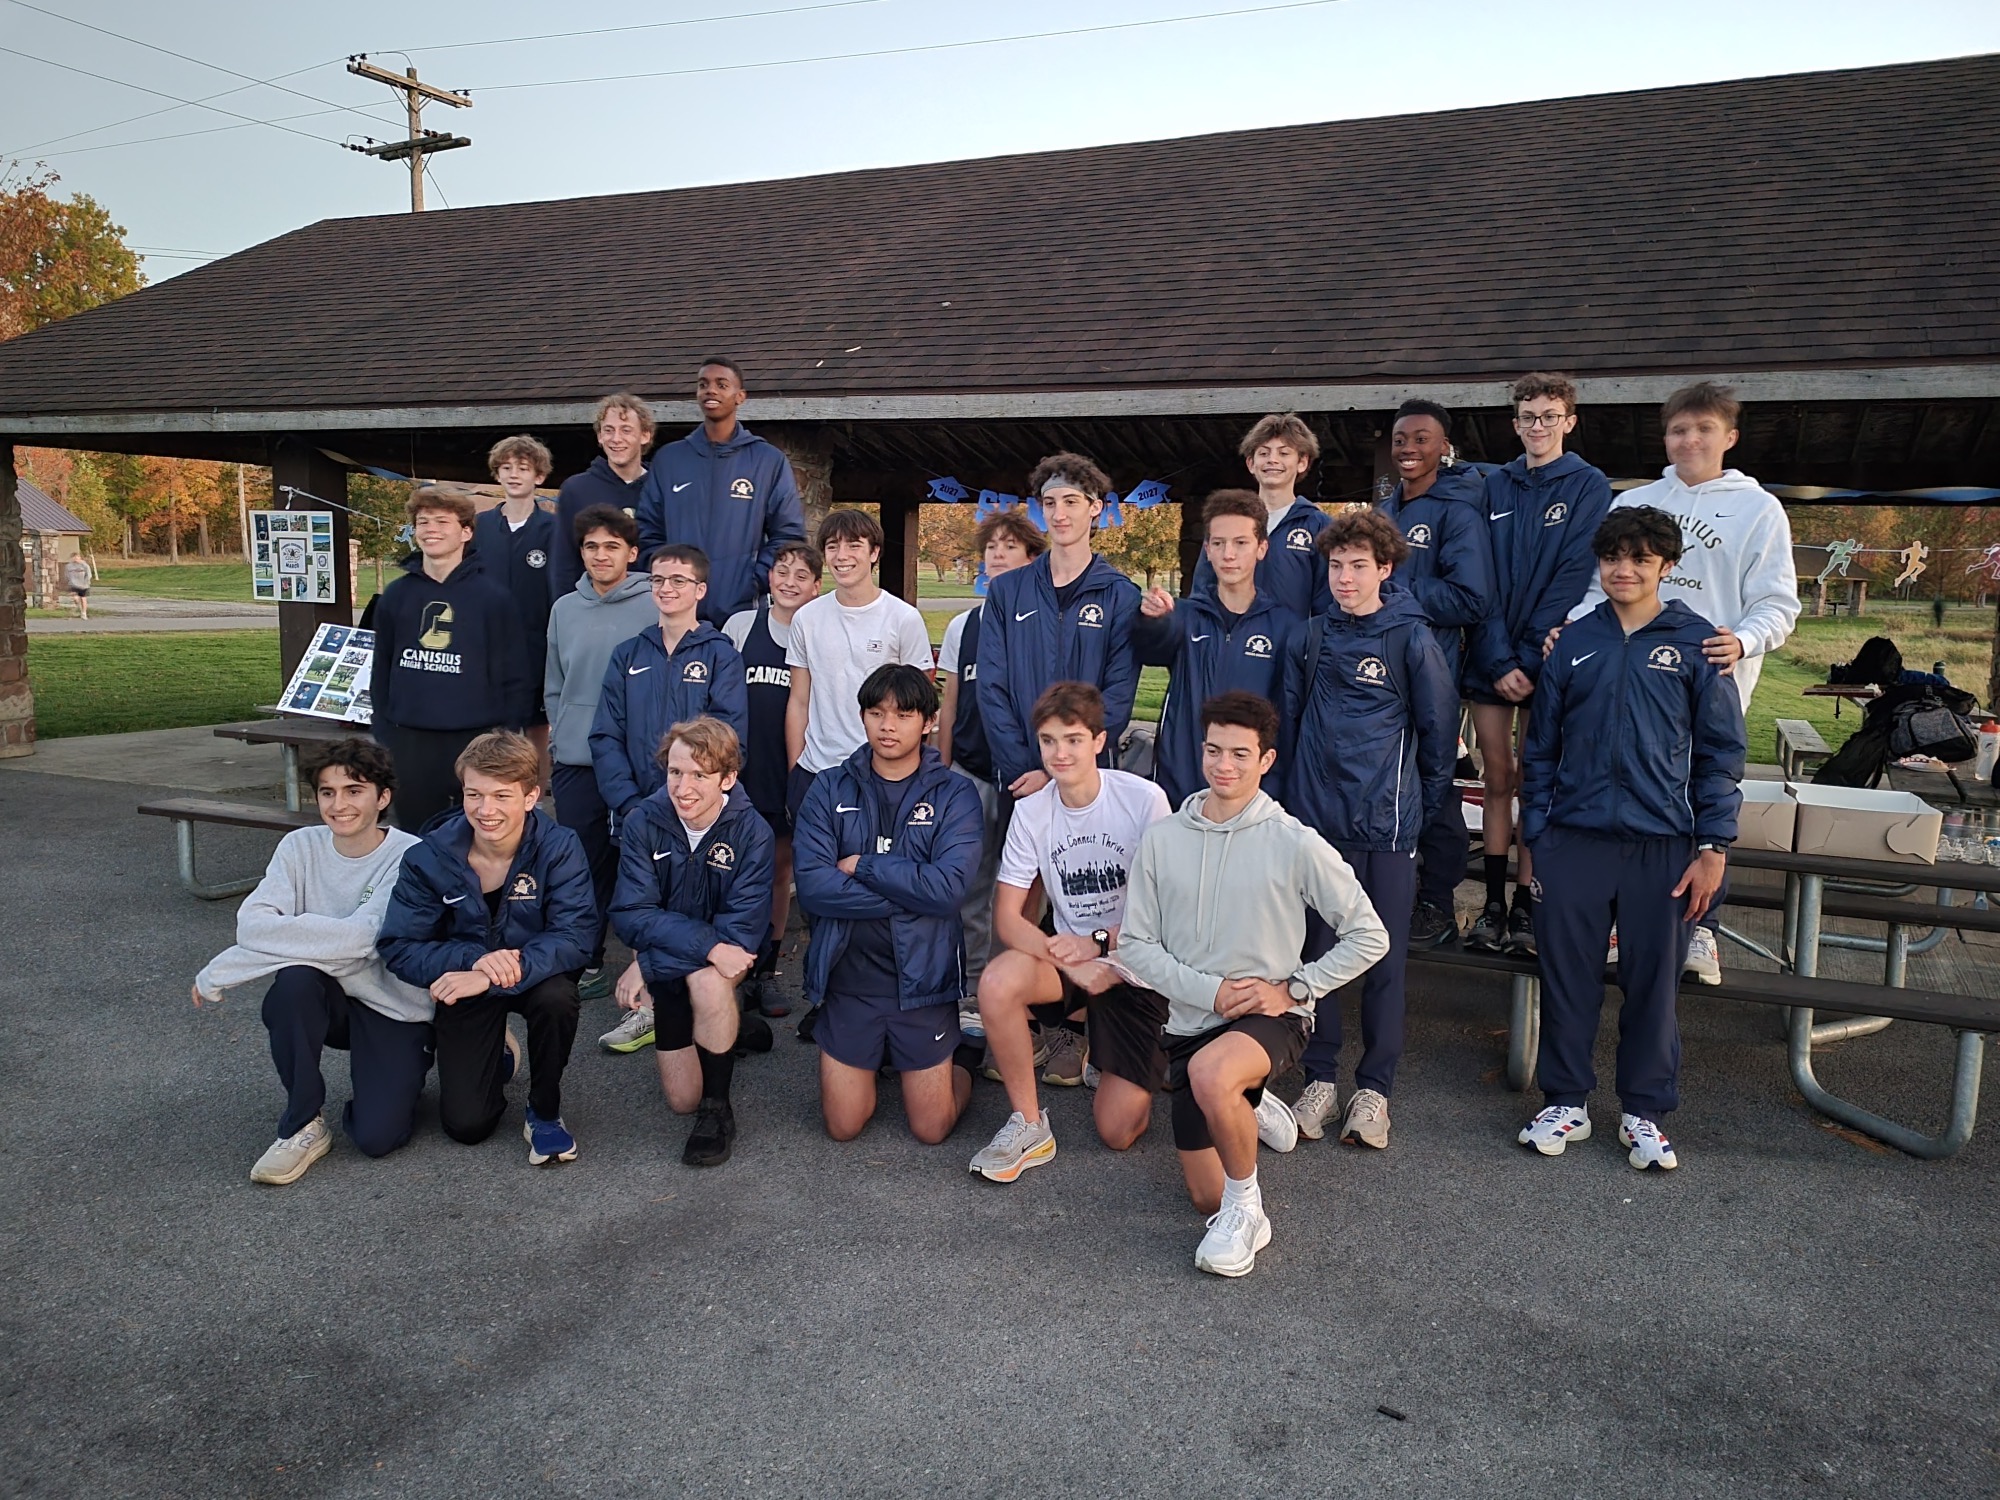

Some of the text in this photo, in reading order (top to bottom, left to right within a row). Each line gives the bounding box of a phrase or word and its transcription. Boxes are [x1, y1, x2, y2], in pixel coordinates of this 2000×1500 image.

[940, 484, 958, 496] 2027
[1138, 487, 1157, 501] 2027
[1661, 576, 1703, 590] CHOOL
[402, 648, 462, 666] CANISIUS
[399, 659, 463, 674] HIGH SCHOOL
[745, 666, 792, 688] CANIS
